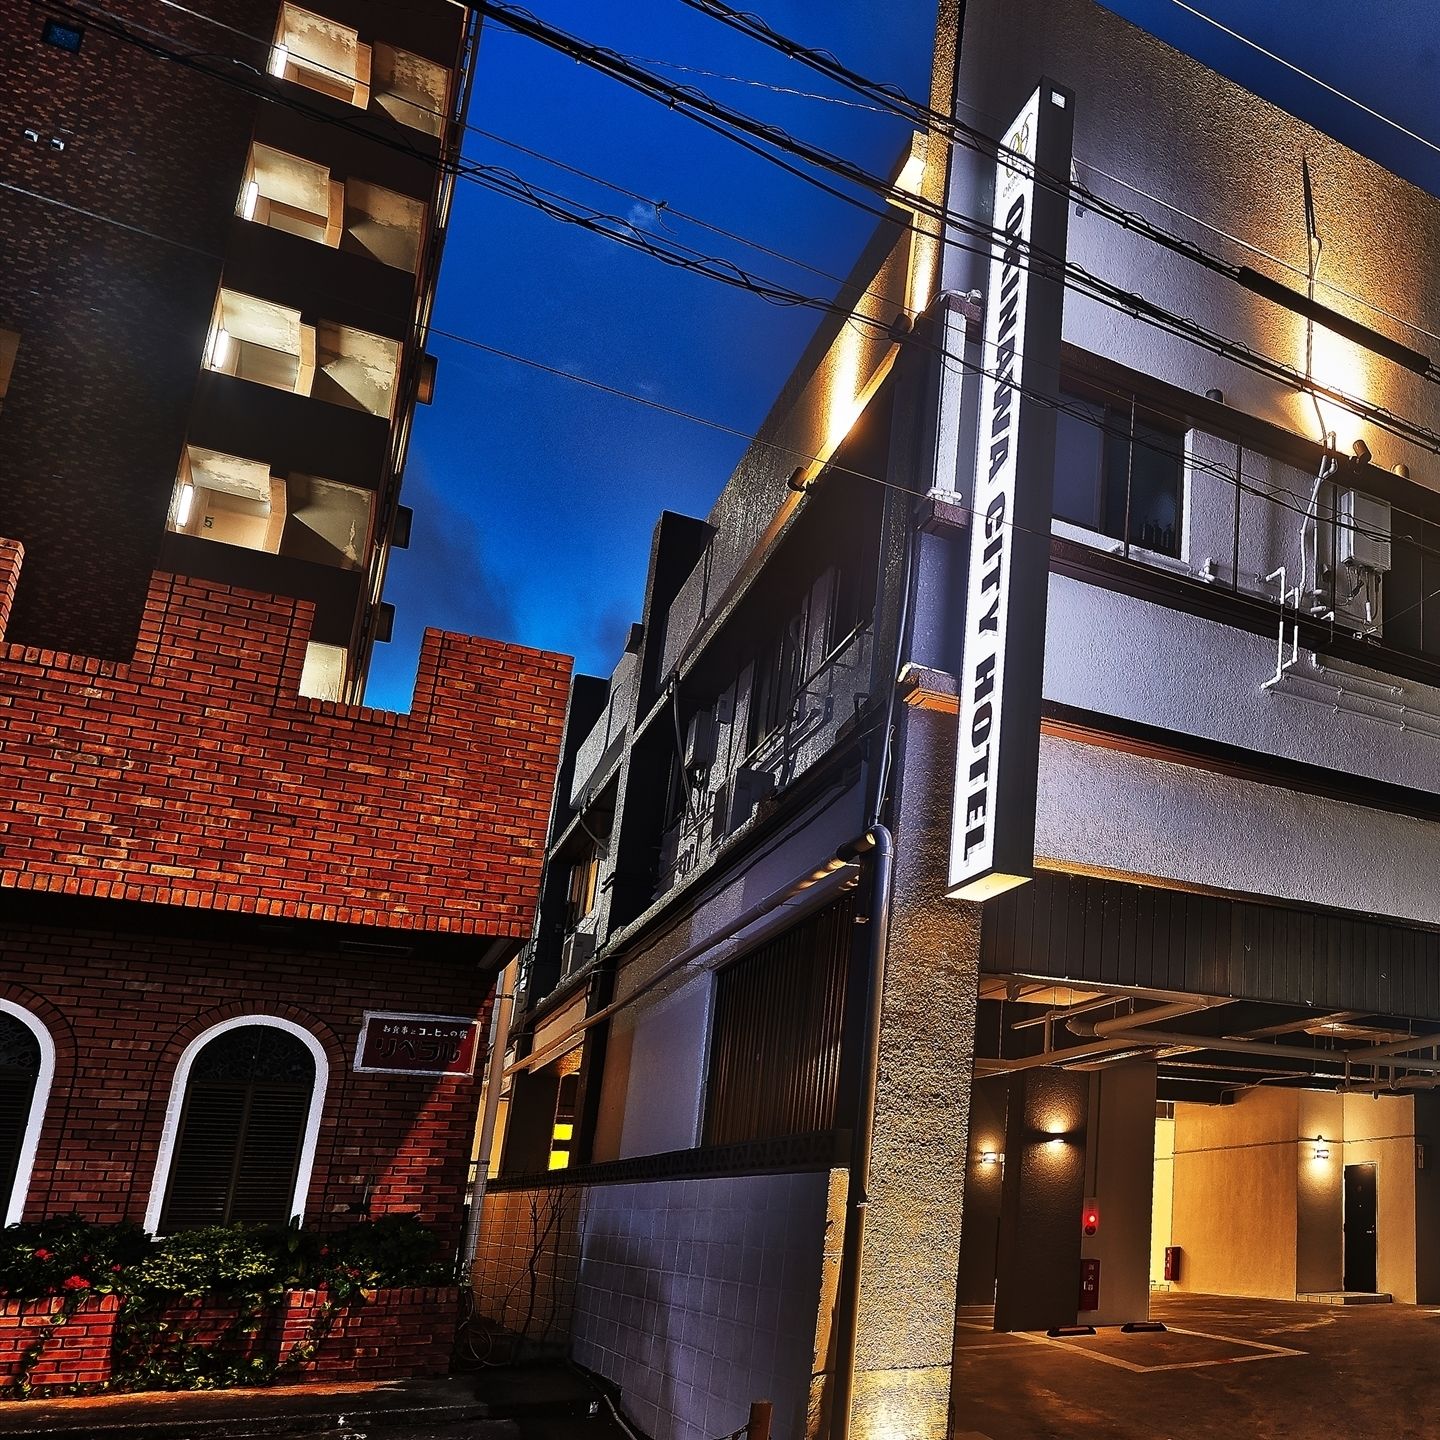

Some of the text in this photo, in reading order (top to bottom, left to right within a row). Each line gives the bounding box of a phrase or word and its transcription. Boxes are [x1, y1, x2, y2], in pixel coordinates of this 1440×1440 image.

[988, 193, 1025, 483] OKINAWA
[978, 491, 1005, 634] CITY
[963, 653, 996, 864] HOTEL
